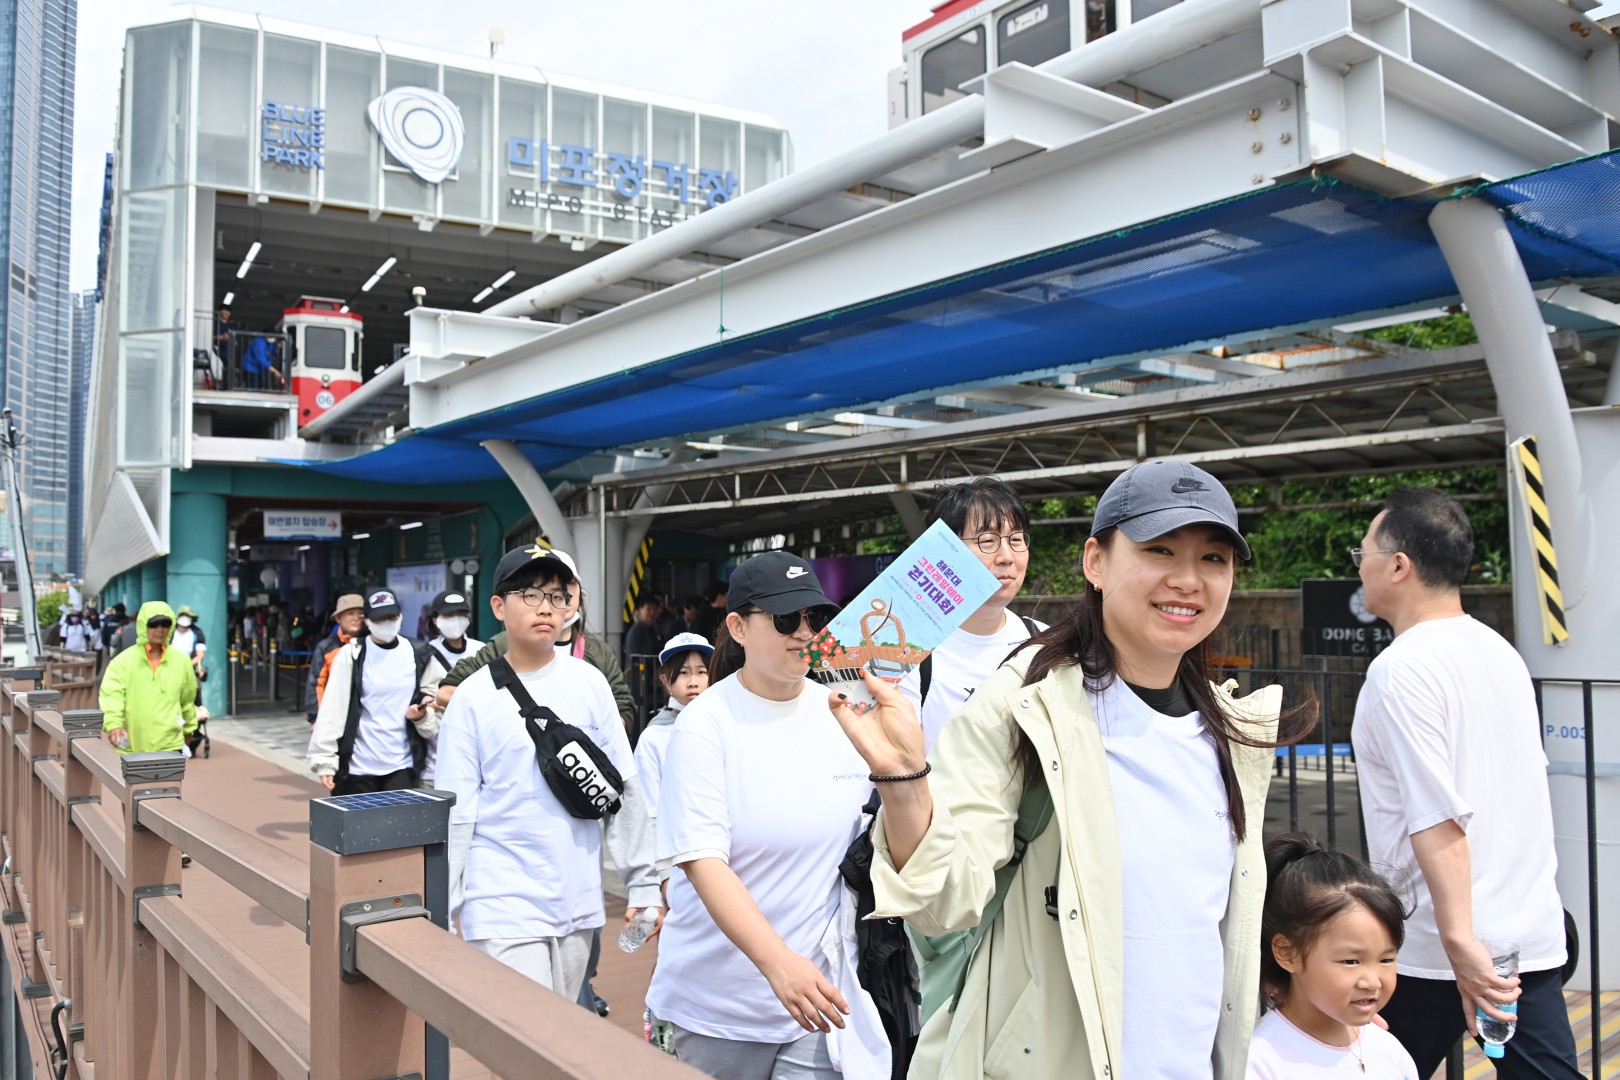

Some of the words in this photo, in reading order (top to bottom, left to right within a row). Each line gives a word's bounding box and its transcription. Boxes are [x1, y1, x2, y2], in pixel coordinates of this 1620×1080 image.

[263, 100, 325, 126] BLUE
[263, 123, 325, 148] LINE
[263, 144, 325, 169] PARK
[509, 134, 737, 208] 미포정거장
[508, 188, 582, 215] MIPO
[613, 203, 689, 227] STAT
[318, 395, 332, 405] 06
[917, 556, 965, 606] 그린레일웨이
[936, 560, 962, 587] 해운대
[907, 564, 956, 616] 걷기대회
[1372, 628, 1393, 642] BA
